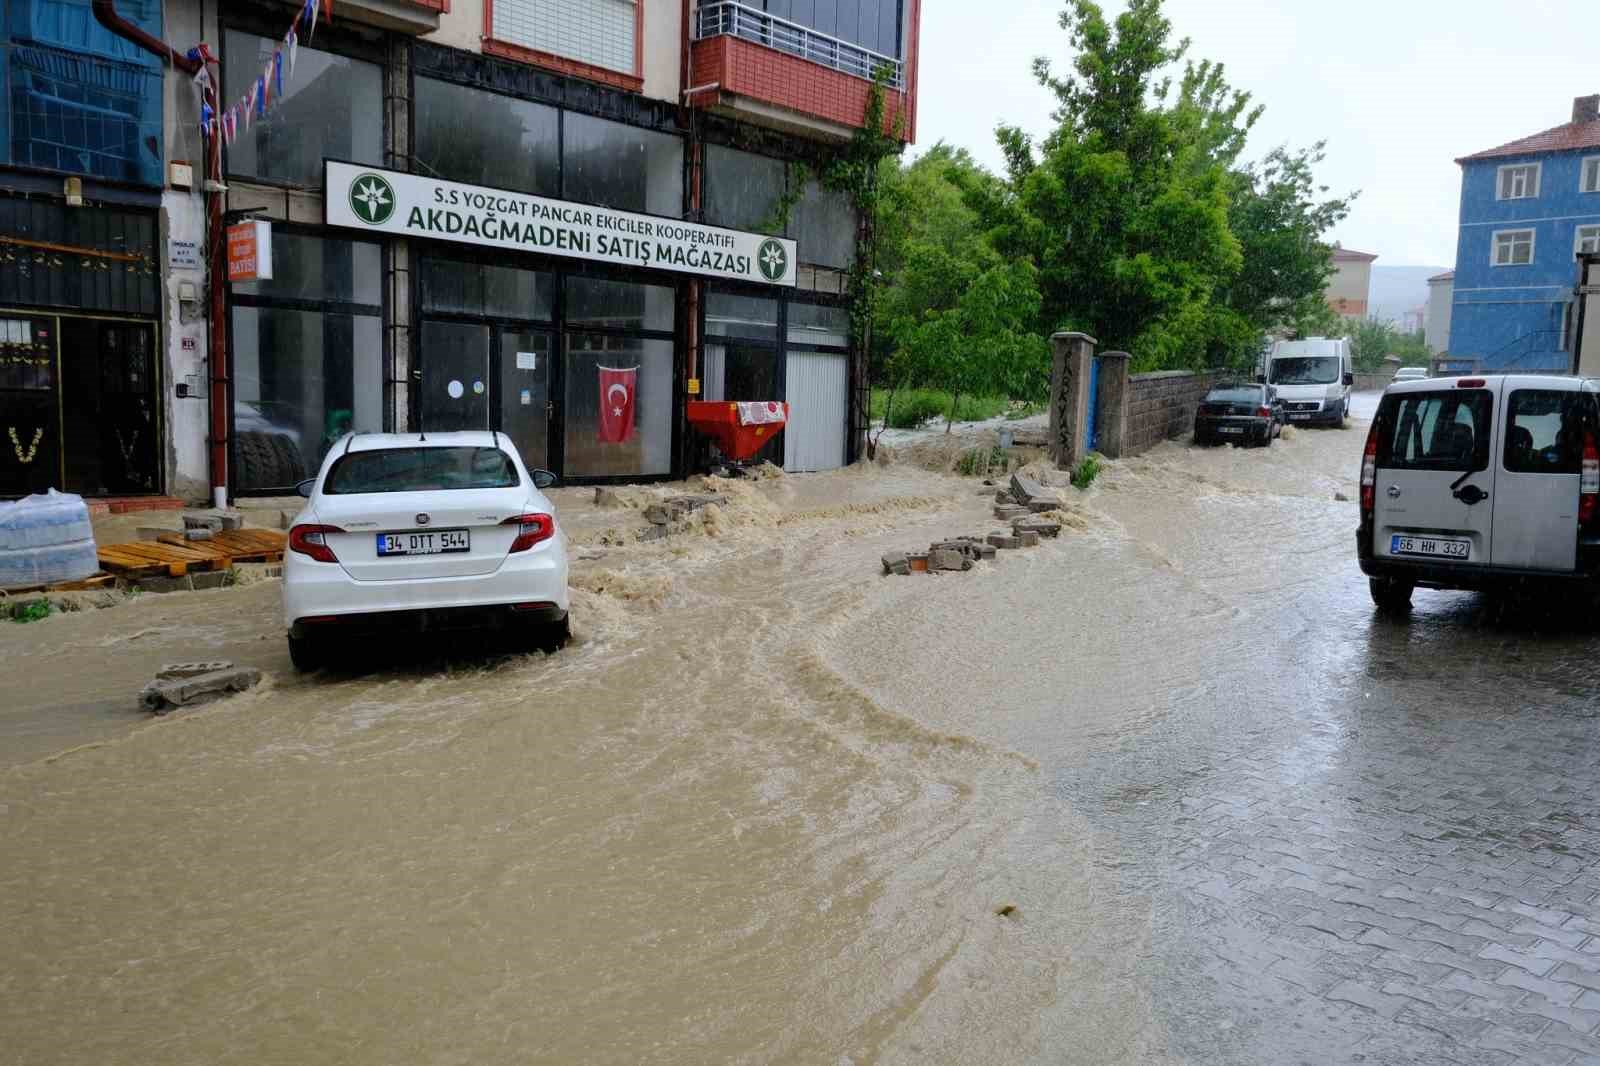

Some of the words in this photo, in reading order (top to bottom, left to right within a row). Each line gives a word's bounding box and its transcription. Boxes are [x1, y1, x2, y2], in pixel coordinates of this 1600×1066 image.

[434, 187, 458, 205] S.S
[462, 191, 527, 215] YOZGAT
[532, 203, 593, 226] PANCAR
[596, 234, 651, 266] SATIŞ
[656, 243, 751, 275] MAĞAZASI
[386, 537, 402, 551] 34
[441, 533, 465, 548] 544
[1400, 539, 1413, 550] 66
[1421, 540, 1435, 553] HH
[1443, 542, 1465, 555] 332
